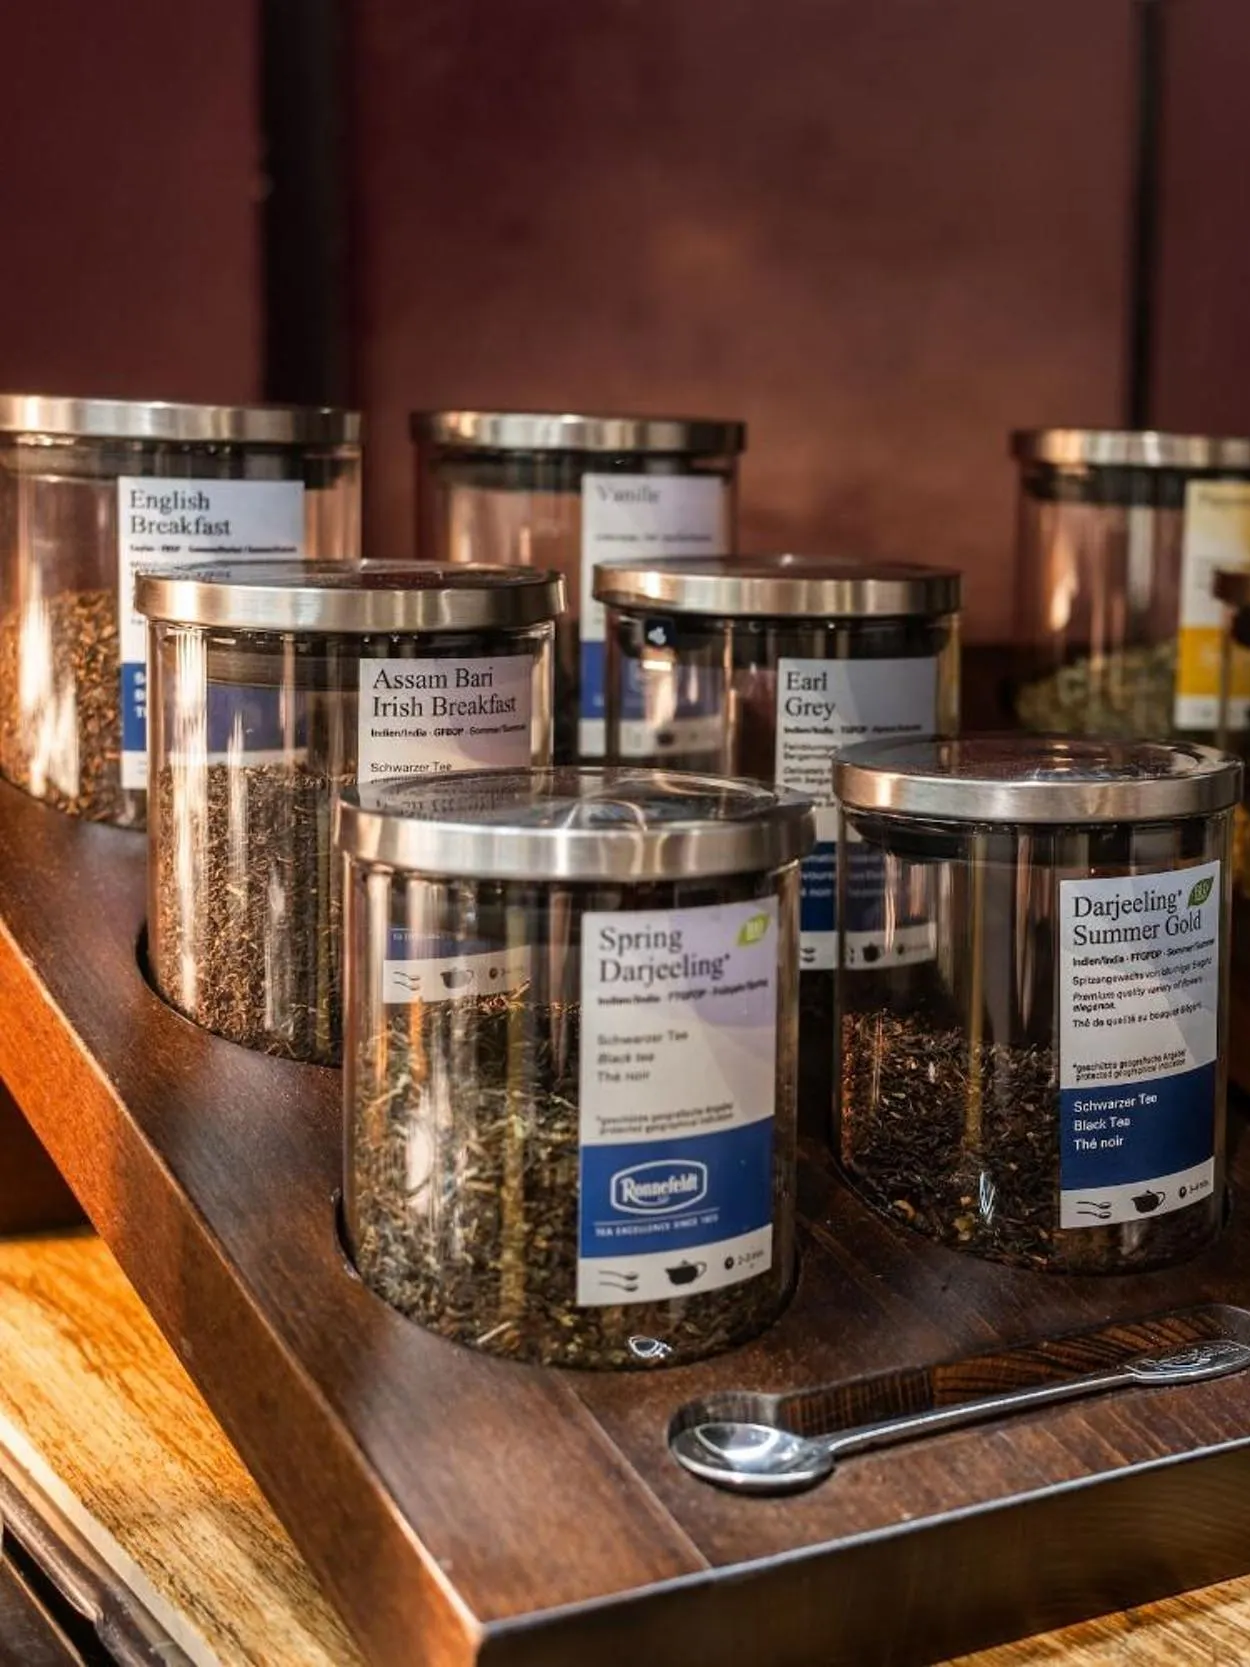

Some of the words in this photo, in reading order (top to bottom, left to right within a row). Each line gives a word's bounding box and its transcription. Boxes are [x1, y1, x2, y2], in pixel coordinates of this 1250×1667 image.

[130, 489, 211, 514] English
[130, 514, 232, 537] Breakfast
[372, 669, 448, 690] Assam
[455, 666, 494, 688] Bari
[785, 671, 828, 692] Earl
[372, 695, 424, 718] Irish
[432, 693, 517, 717] Breakfast
[784, 697, 836, 720] Grey
[370, 762, 430, 773] Schwarzer
[433, 760, 453, 772] Tee
[1073, 924, 1161, 946] Summer
[1165, 910, 1201, 937] Gold
[599, 923, 684, 957] Spring
[1074, 1097, 1136, 1114] Schwarzer
[1138, 1093, 1158, 1105] Tee
[1074, 1118, 1107, 1132] Black
[1110, 1116, 1131, 1128] Tea
[1073, 1138, 1098, 1151] Thé
[1101, 1134, 1124, 1149] noir
[620, 1172, 698, 1206] Ronnefeldt
